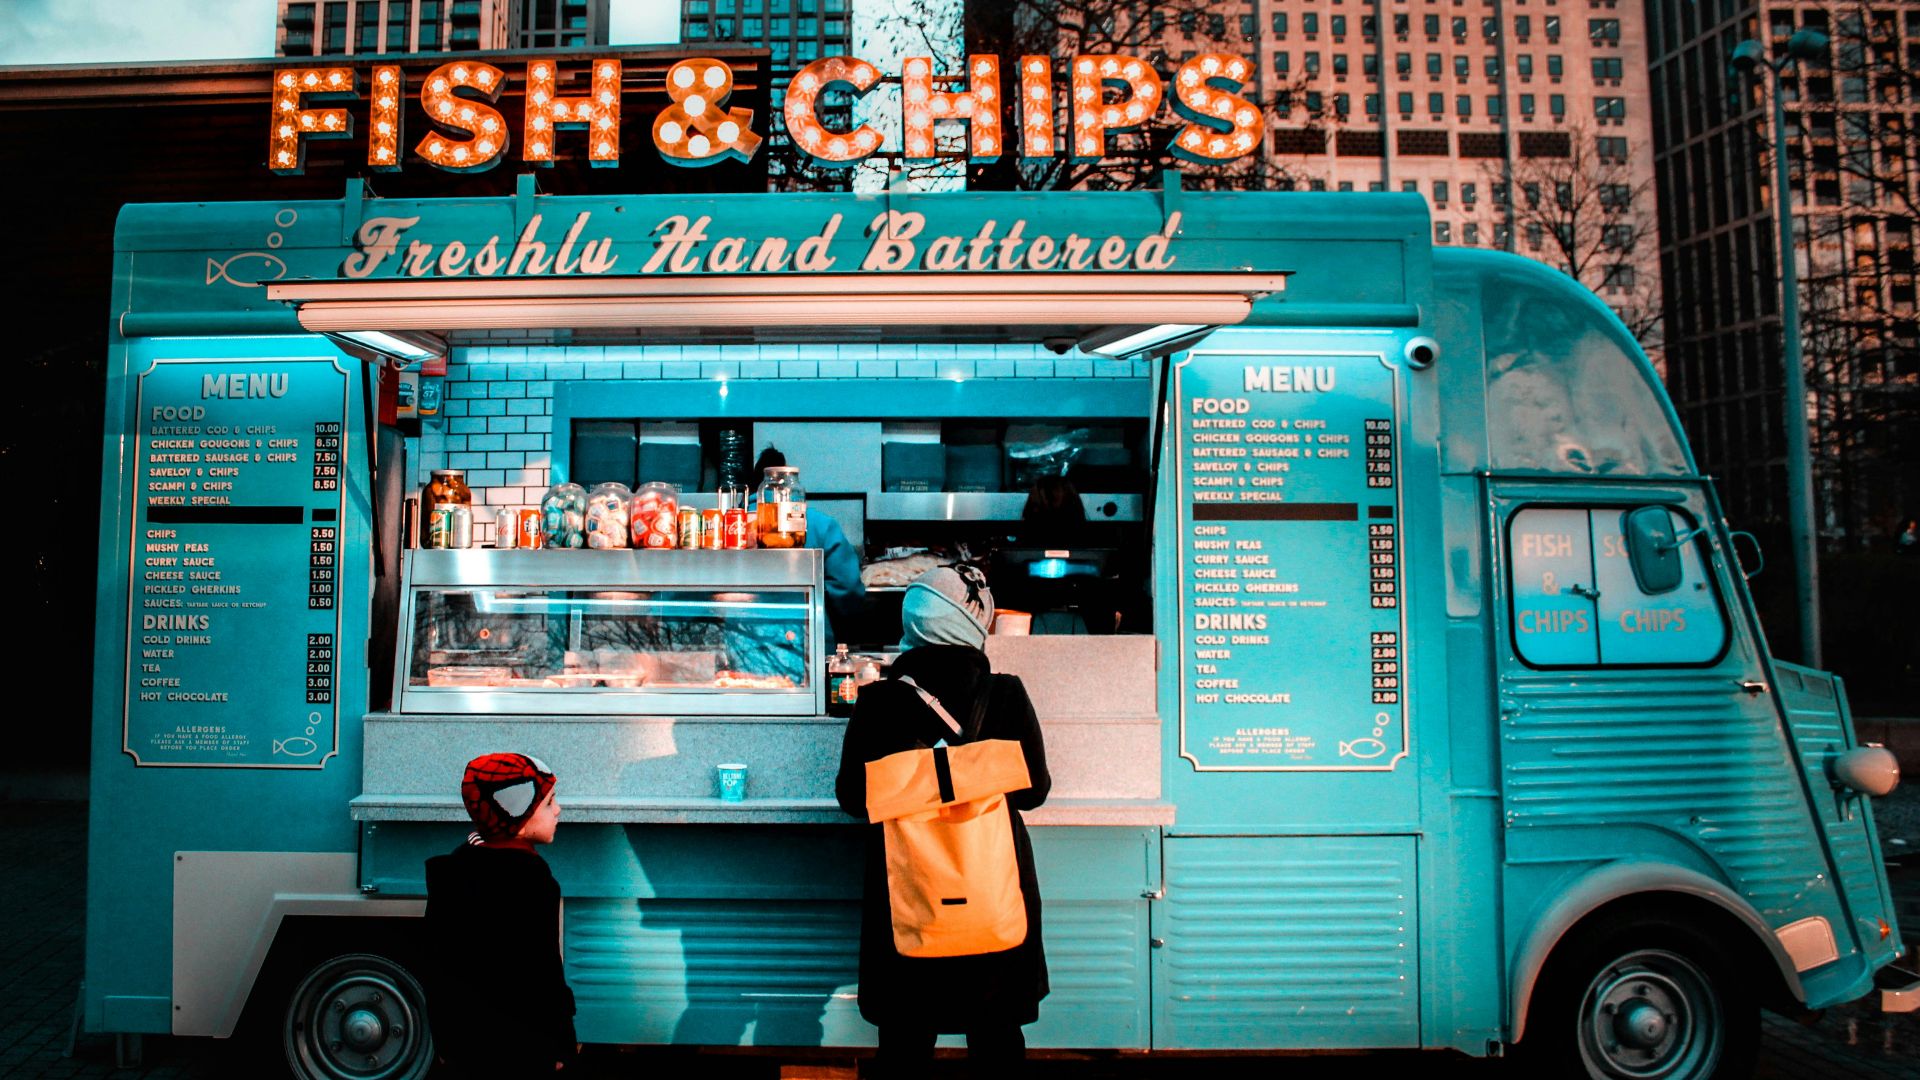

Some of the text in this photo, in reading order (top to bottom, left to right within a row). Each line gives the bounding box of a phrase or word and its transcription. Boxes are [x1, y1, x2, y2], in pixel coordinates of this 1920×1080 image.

[269, 53, 1264, 174] FISH & CHIPS
[641, 213, 842, 274] Hand
[862, 210, 1181, 271] Battered
[1244, 365, 1336, 392] MENU
[203, 373, 289, 398] MENU
[1192, 398, 1250, 413] FOOD
[152, 406, 206, 421] FOOD
[315, 424, 339, 433] 10.00
[1193, 419, 1246, 428] BATTERED
[1252, 419, 1276, 428] COD
[1294, 419, 1326, 429] CHIPS
[152, 425, 200, 435] BATTERED
[207, 425, 228, 435] COD
[247, 425, 276, 434] CHIPS
[1193, 434, 1240, 443] CHICKEN
[1245, 434, 1299, 443] GOUGONS
[1318, 434, 1350, 443] CHIPS
[151, 440, 194, 449] CHICKEN
[200, 440, 250, 449] GOUGONS
[269, 439, 298, 448] CHIPS
[316, 439, 338, 448] 8.50
[316, 453, 336, 461] 7.50
[1193, 448, 1246, 457] BATTERED
[1252, 448, 1299, 457] SAUSAGE
[1318, 448, 1349, 457] CHIPS
[150, 453, 199, 463] BATTERED
[205, 453, 248, 463] SAUSAGE
[267, 453, 297, 462] CHIPS
[315, 467, 336, 475] 7.50
[1193, 462, 1238, 471] SAVELOY
[1257, 462, 1289, 472] CHIPS
[150, 468, 191, 477] SAVELOY
[209, 468, 239, 477] CHIPS
[314, 480, 335, 490] 8.50
[1194, 477, 1233, 486] SCAMPI
[1252, 477, 1284, 486] CHIPS
[149, 482, 185, 491] SCAMPI
[203, 482, 232, 491] CHIPS
[148, 496, 230, 505] WEEKLY SPECIAL
[1194, 491, 1282, 501] WEEKLY SPECIAL
[147, 530, 176, 538] CHIPS
[313, 529, 334, 538] 3.50
[1194, 526, 1227, 535] CHIPS
[146, 544, 209, 552] MUSHY PEAS
[313, 543, 332, 553] 1.50
[1194, 540, 1262, 550] MUSHY PEAS
[1521, 534, 1573, 557] FISH
[146, 558, 214, 566] CURRY SAUCE
[313, 556, 332, 565] 1.50
[1194, 554, 1269, 564] CURRY SAUCE
[145, 571, 221, 580] CHEESE SAUCE
[312, 570, 331, 579] 1.50
[1195, 569, 1276, 578] CHEESE SAUCE
[1195, 583, 1299, 592] PICKLED GHERKINS
[1541, 572, 1559, 594] &
[145, 585, 241, 593] PICKLED GHERKINS
[312, 585, 331, 593] 1.00
[310, 598, 331, 607] 0.50
[143, 615, 209, 630] DRINKS
[1195, 614, 1267, 629] DRINKS
[1518, 609, 1589, 633] CHIPS
[1619, 609, 1686, 632] CHIPS
[143, 636, 211, 644] COLD DRINKS
[309, 636, 330, 645] 2.00
[1196, 635, 1270, 644] COLD DRINKS
[142, 650, 174, 658] WATER
[309, 650, 331, 659] 2.00
[1196, 649, 1231, 659] WATER
[142, 664, 160, 672] TEA
[308, 664, 330, 673] 2.00
[1196, 664, 1217, 673] TEA
[141, 678, 180, 687] COFFEE
[308, 679, 329, 687] 3.00
[1196, 679, 1239, 688] COFFEE
[141, 692, 228, 701] HOT CHOCOLATE
[308, 693, 329, 701] 3.00
[1196, 694, 1290, 703] HOT CHOCOLATE
